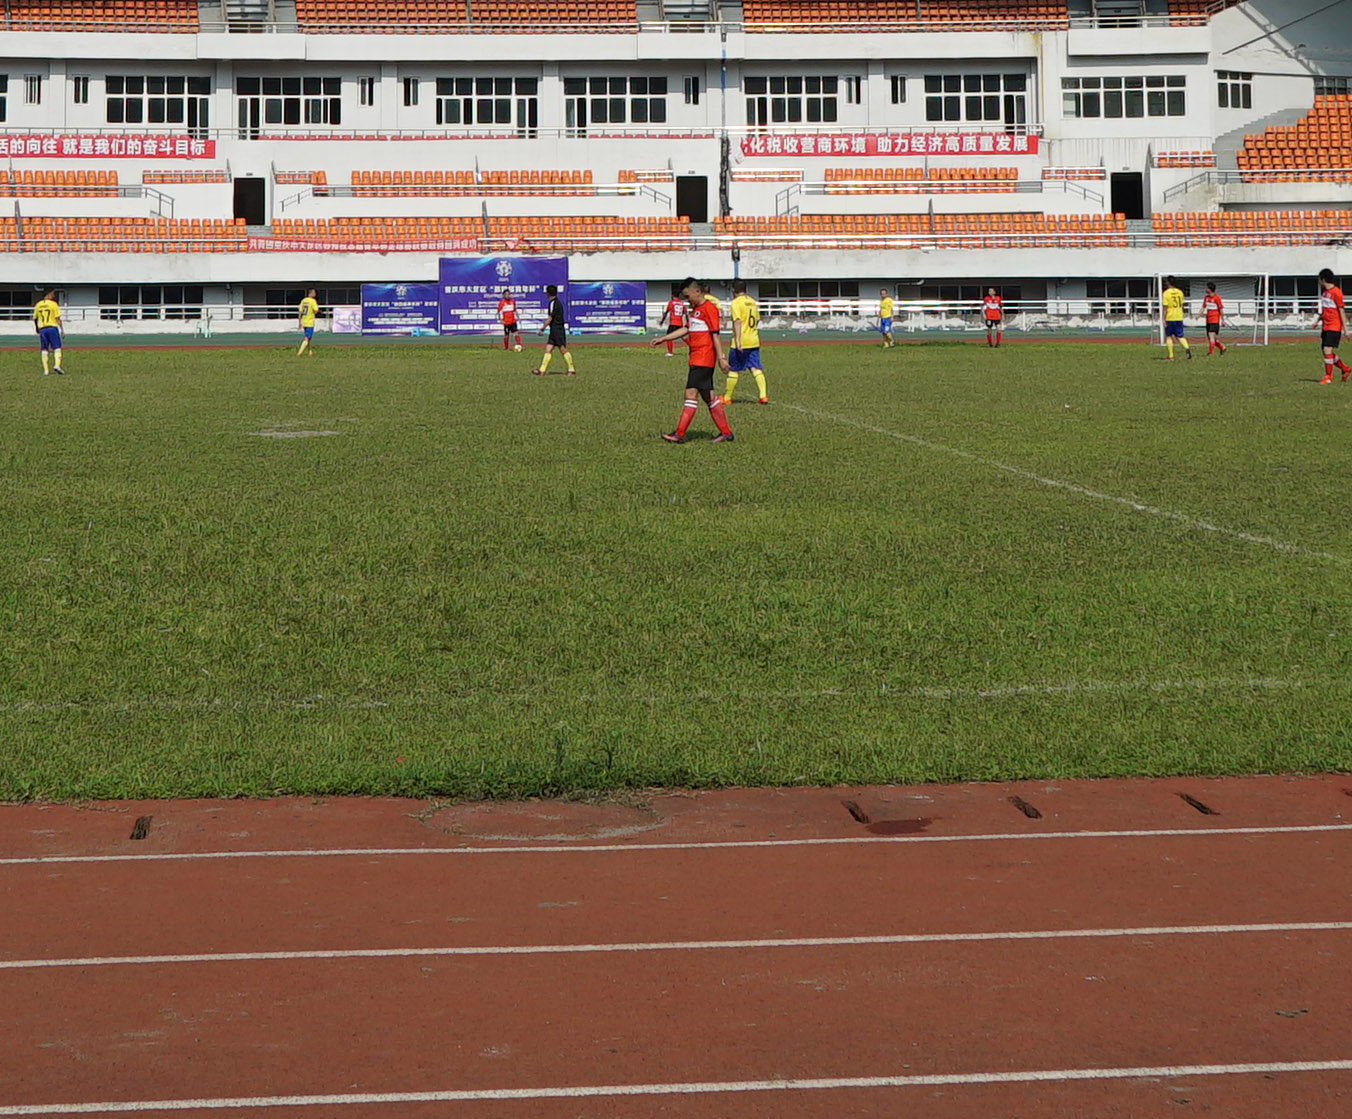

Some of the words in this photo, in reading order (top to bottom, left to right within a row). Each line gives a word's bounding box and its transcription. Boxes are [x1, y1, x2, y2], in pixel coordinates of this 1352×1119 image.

[62, 138, 206, 155] 就是我们的奋斗目标
[876, 135, 1029, 153] 助力经济高质量发展
[748, 309, 756, 328] 6
